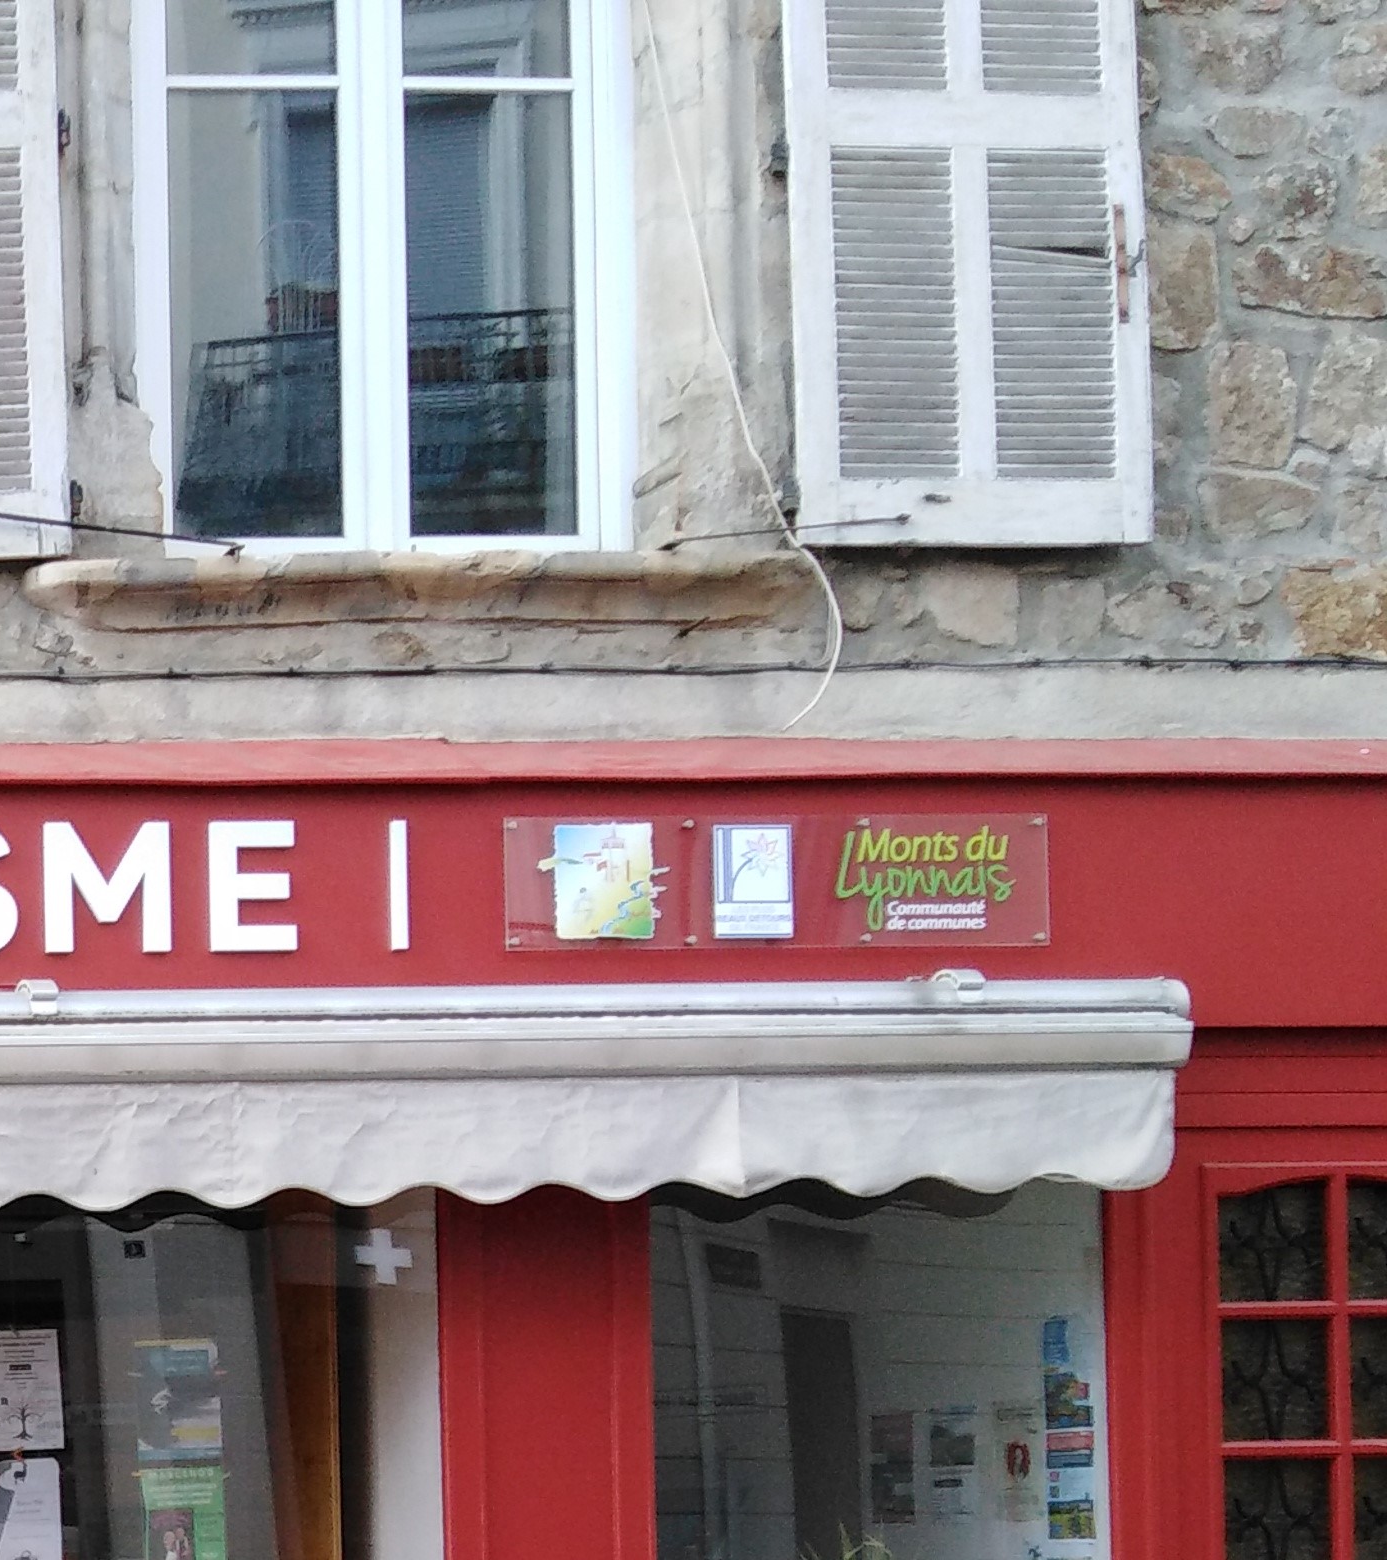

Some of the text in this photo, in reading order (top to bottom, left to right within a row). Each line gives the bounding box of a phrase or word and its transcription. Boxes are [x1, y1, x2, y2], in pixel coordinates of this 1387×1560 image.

[856, 825, 1009, 863] Monts du
[835, 830, 1017, 931] Lyonnais
[887, 900, 987, 916] Communauté
[887, 916, 987, 930] de communes
